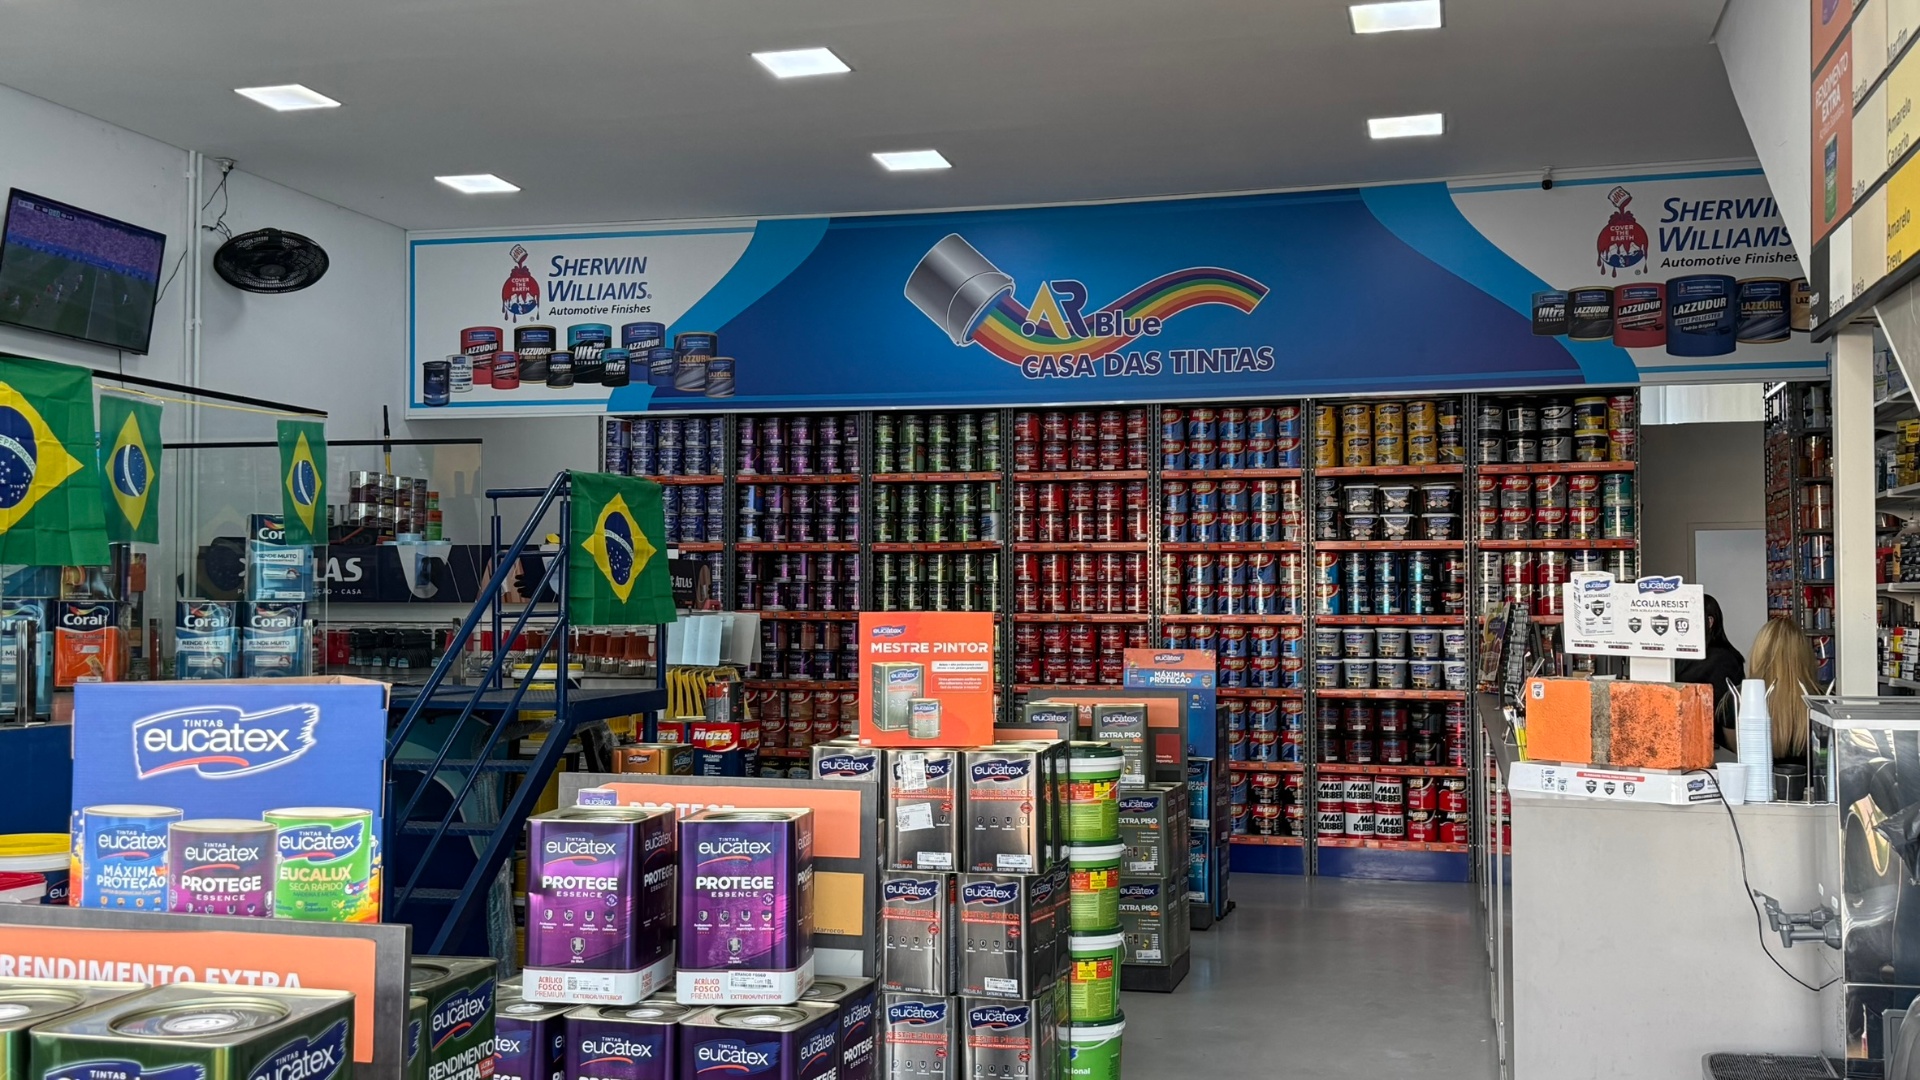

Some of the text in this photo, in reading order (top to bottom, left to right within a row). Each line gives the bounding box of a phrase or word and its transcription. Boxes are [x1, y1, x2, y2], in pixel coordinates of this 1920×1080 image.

[1816, 51, 1848, 109] RENDIMENTO
[1822, 84, 1841, 122] EXTRA
[1887, 98, 1912, 135] Amarelo
[1887, 134, 1909, 167] Canário
[1610, 224, 1634, 232] COVER
[1887, 207, 1910, 240] Amarelo
[1659, 226, 1791, 252] WILLIAMS
[549, 255, 647, 277] SHERWIN
[1661, 251, 1799, 268] Automotive Finishes
[1887, 249, 1902, 272] Frevo
[547, 280, 648, 302] WILLIAMS
[549, 304, 651, 316] Automotive Finishes
[1573, 305, 1610, 314] LAZZUDUR
[1618, 300, 1662, 316] LAZZUDUR
[1673, 297, 1727, 316] LAZZUDUR
[1741, 301, 1783, 311] LAZZURIL
[1829, 295, 1845, 316] Branco
[1538, 307, 1565, 318] Ultra
[1094, 309, 1163, 338] Blue
[465, 342, 498, 355] LAZZUDUR
[625, 338, 660, 351] LAZZUDUR
[605, 362, 626, 371] Ultra
[1021, 346, 1275, 379] CASA DAS TINTAS
[258, 527, 284, 541] Cor
[312, 557, 363, 582] LAS
[674, 575, 693, 589] ATLAS
[1639, 580, 1676, 590] eucatex
[1630, 599, 1689, 608] ACQUA RESIST
[63, 613, 102, 626] Coral
[184, 615, 225, 628] Coral
[251, 615, 291, 628] Coral
[1677, 620, 1688, 629] 10
[871, 642, 988, 654] MESTRE PINTOR
[1154, 670, 1185, 678] MÁXIMA
[183, 719, 223, 727] TINTAS
[1032, 714, 1067, 723] eucatex
[1103, 714, 1138, 723] eucatex
[143, 723, 290, 752] eucatex
[693, 730, 732, 742] Maza
[821, 759, 869, 771] eucatex
[974, 765, 1024, 775] eucatex
[1320, 783, 1342, 791] MAXI
[1350, 783, 1372, 791] MAXI
[585, 797, 612, 806] eucatex
[1318, 791, 1343, 799] RUBBER
[1346, 791, 1372, 799] RUBBER
[1375, 794, 1401, 802] RUBBER
[1120, 800, 1154, 808] eucatex
[1321, 814, 1343, 822] MAXI
[1381, 818, 1401, 826] MAXI
[1318, 822, 1343, 830] RUBBER
[1376, 826, 1403, 834] RUBBER
[98, 832, 167, 850] eucatex
[279, 833, 355, 850] eucatex
[546, 839, 617, 855] eucatex
[645, 831, 672, 851] eucatex
[699, 841, 772, 854] eucatex
[185, 845, 259, 861] eucatex
[103, 862, 157, 878] MÁXIMA
[281, 863, 353, 882] EUCALUX
[644, 864, 674, 888] PROTEGE
[96, 874, 166, 890] PROTEÇÃO
[181, 875, 262, 893] PROTEGE
[289, 879, 343, 891] SECA RÁPIDO
[542, 876, 618, 891] PROTEGE
[696, 876, 774, 890] PROTEGE
[887, 883, 932, 896] eucatex
[965, 886, 1011, 898] eucatex
[1120, 887, 1154, 895] eucatex
[538, 975, 562, 983] ACRÍLICO
[694, 977, 719, 985] ACRÍLICO
[538, 983, 562, 991] FOSCO
[694, 985, 720, 993] FOSCO
[535, 990, 566, 998] PREMIUM
[573, 993, 622, 1001] EXTERIOR/INTERIOR
[730, 993, 782, 1001] EXTERIOR/INTERIOR
[432, 996, 486, 1032] eucatex
[843, 1002, 872, 1028] eucatex
[891, 1006, 939, 1019] eucatex
[972, 1010, 1022, 1023] eucatex
[581, 1039, 652, 1058] eucatex
[801, 1033, 836, 1060] eucatex
[843, 1040, 873, 1065] PROTEGE
[276, 1051, 299, 1065] TINTAS
[428, 1039, 494, 1080] RENDIMENTO
[699, 1045, 769, 1066] eucatex
[90, 1070, 127, 1079] TINTAS
